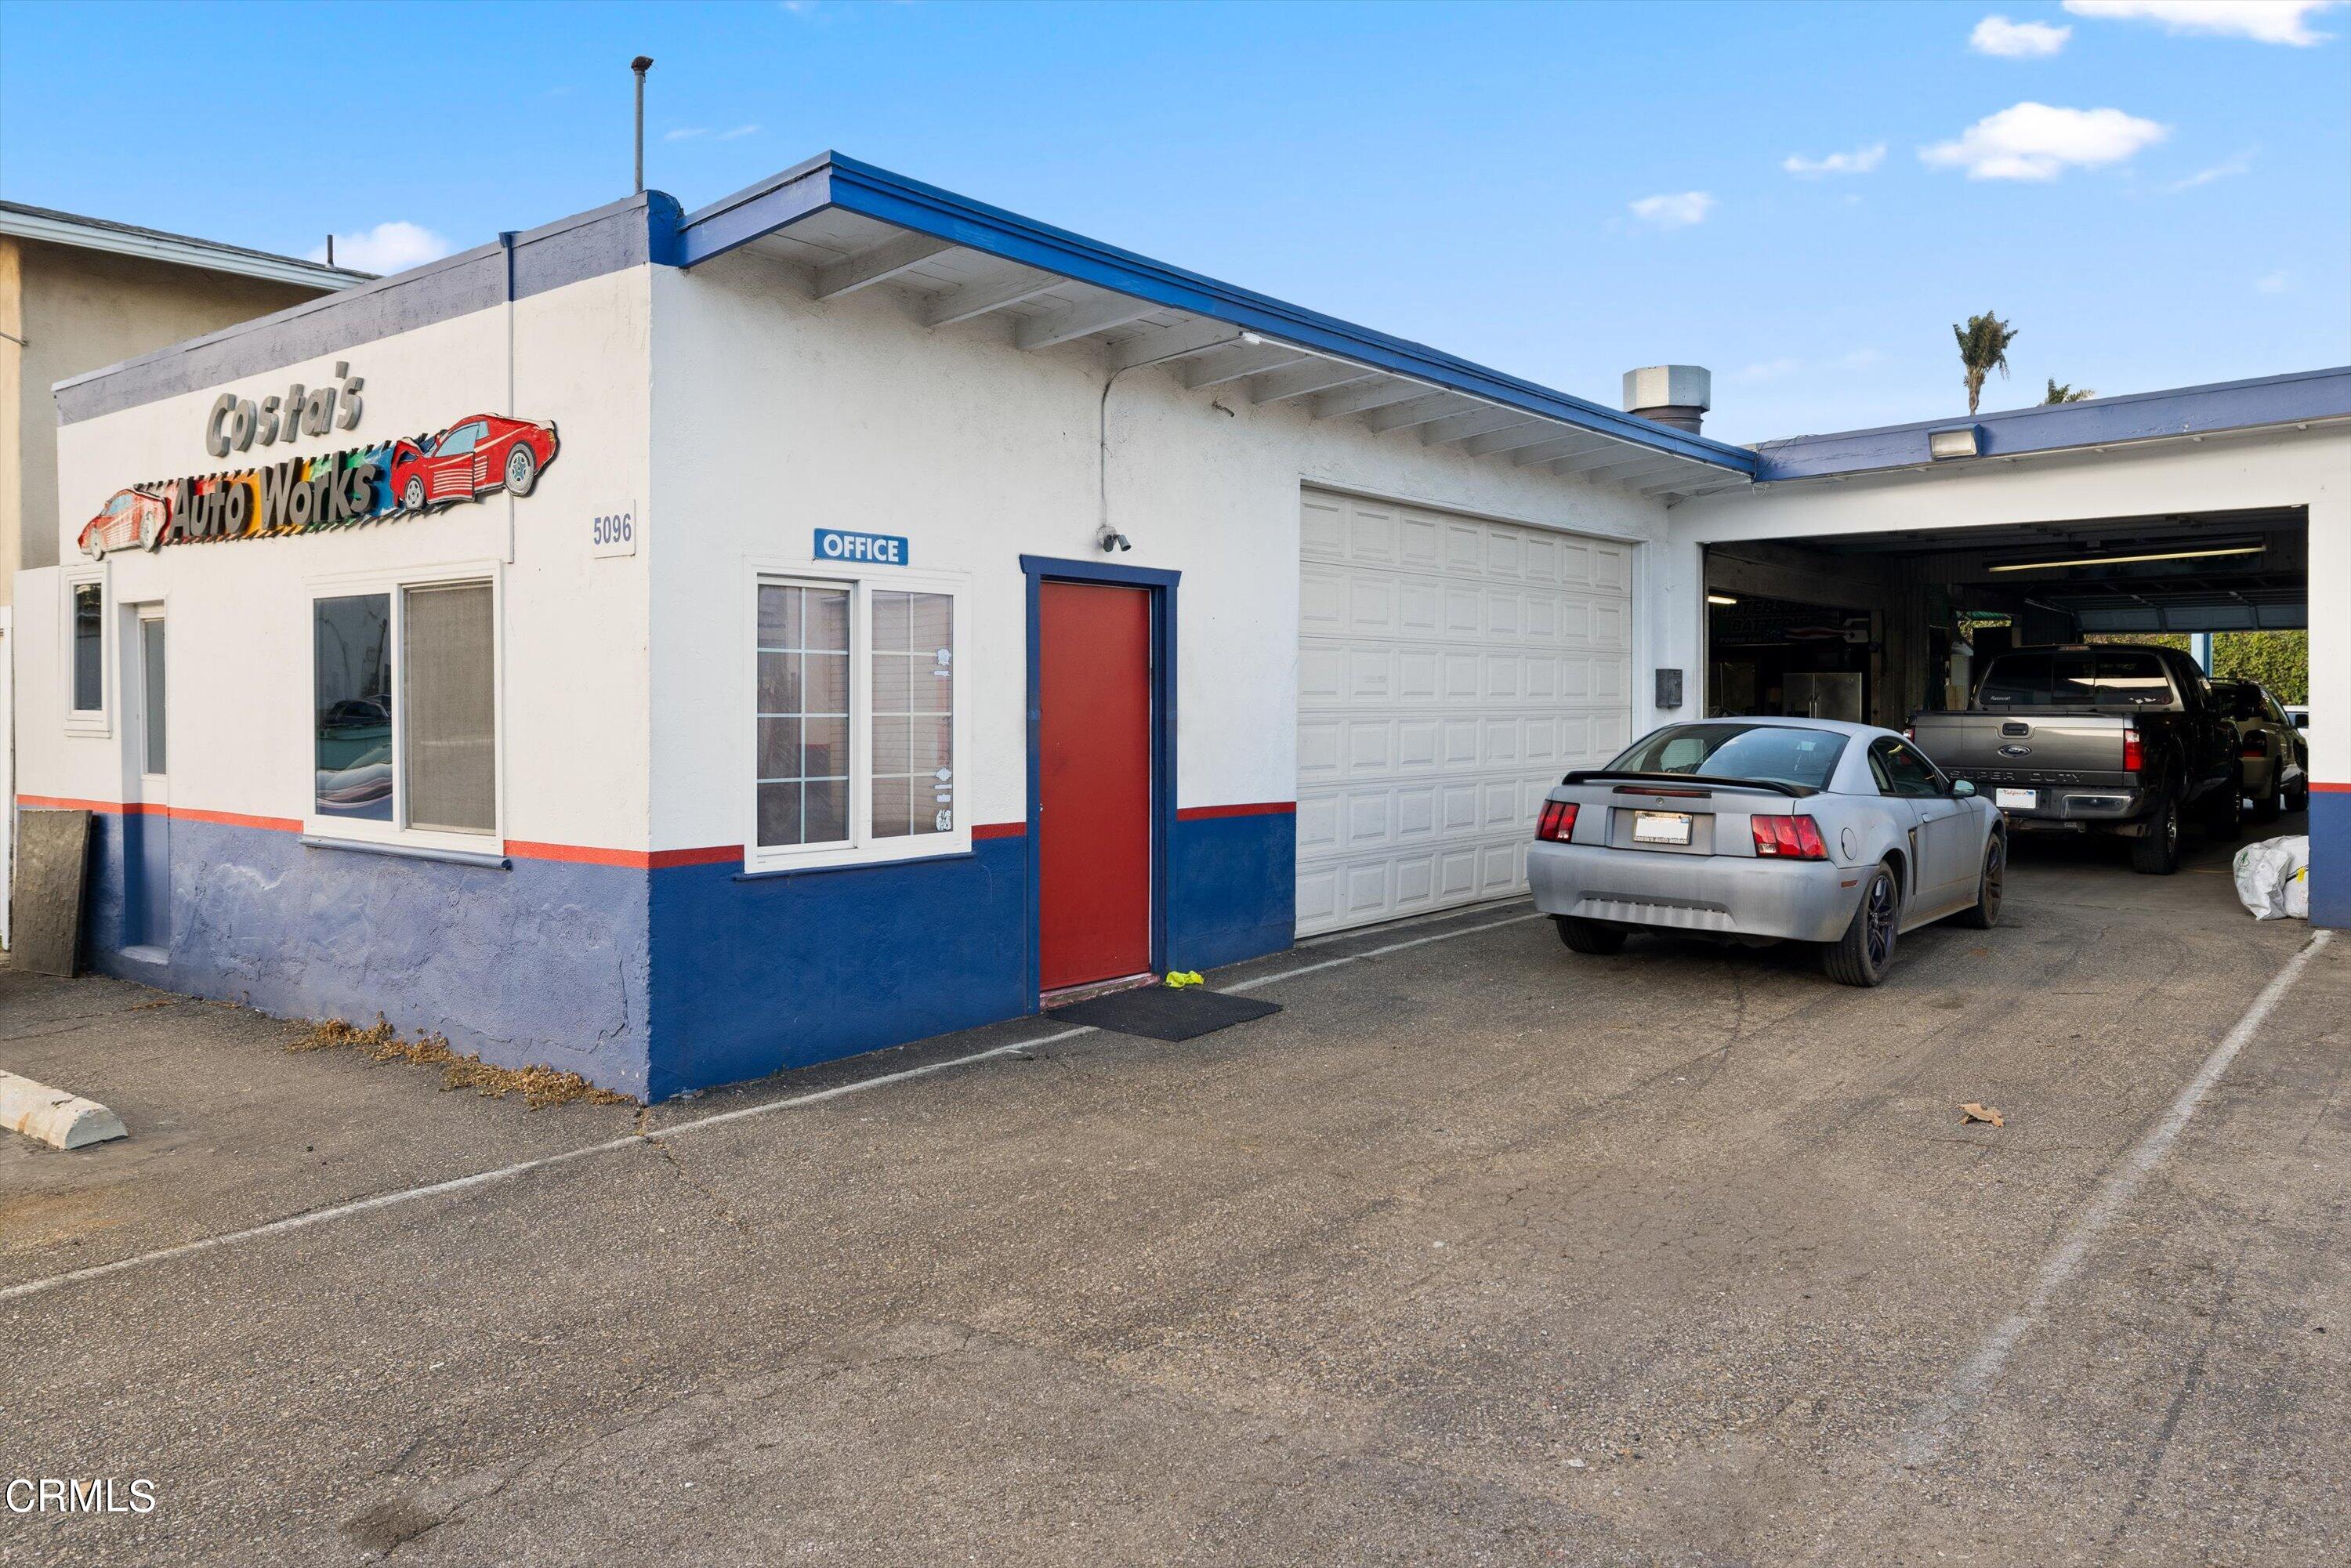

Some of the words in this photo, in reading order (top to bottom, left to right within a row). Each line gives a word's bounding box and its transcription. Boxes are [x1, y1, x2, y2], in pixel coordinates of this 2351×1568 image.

[206, 360, 364, 458] Costa's
[168, 478, 254, 538] Auto
[259, 451, 384, 531] Works
[593, 512, 632, 545] 5096
[823, 534, 899, 562] OFFICE
[1950, 770, 2015, 781] SUPER
[2030, 773, 2085, 783] DUTY
